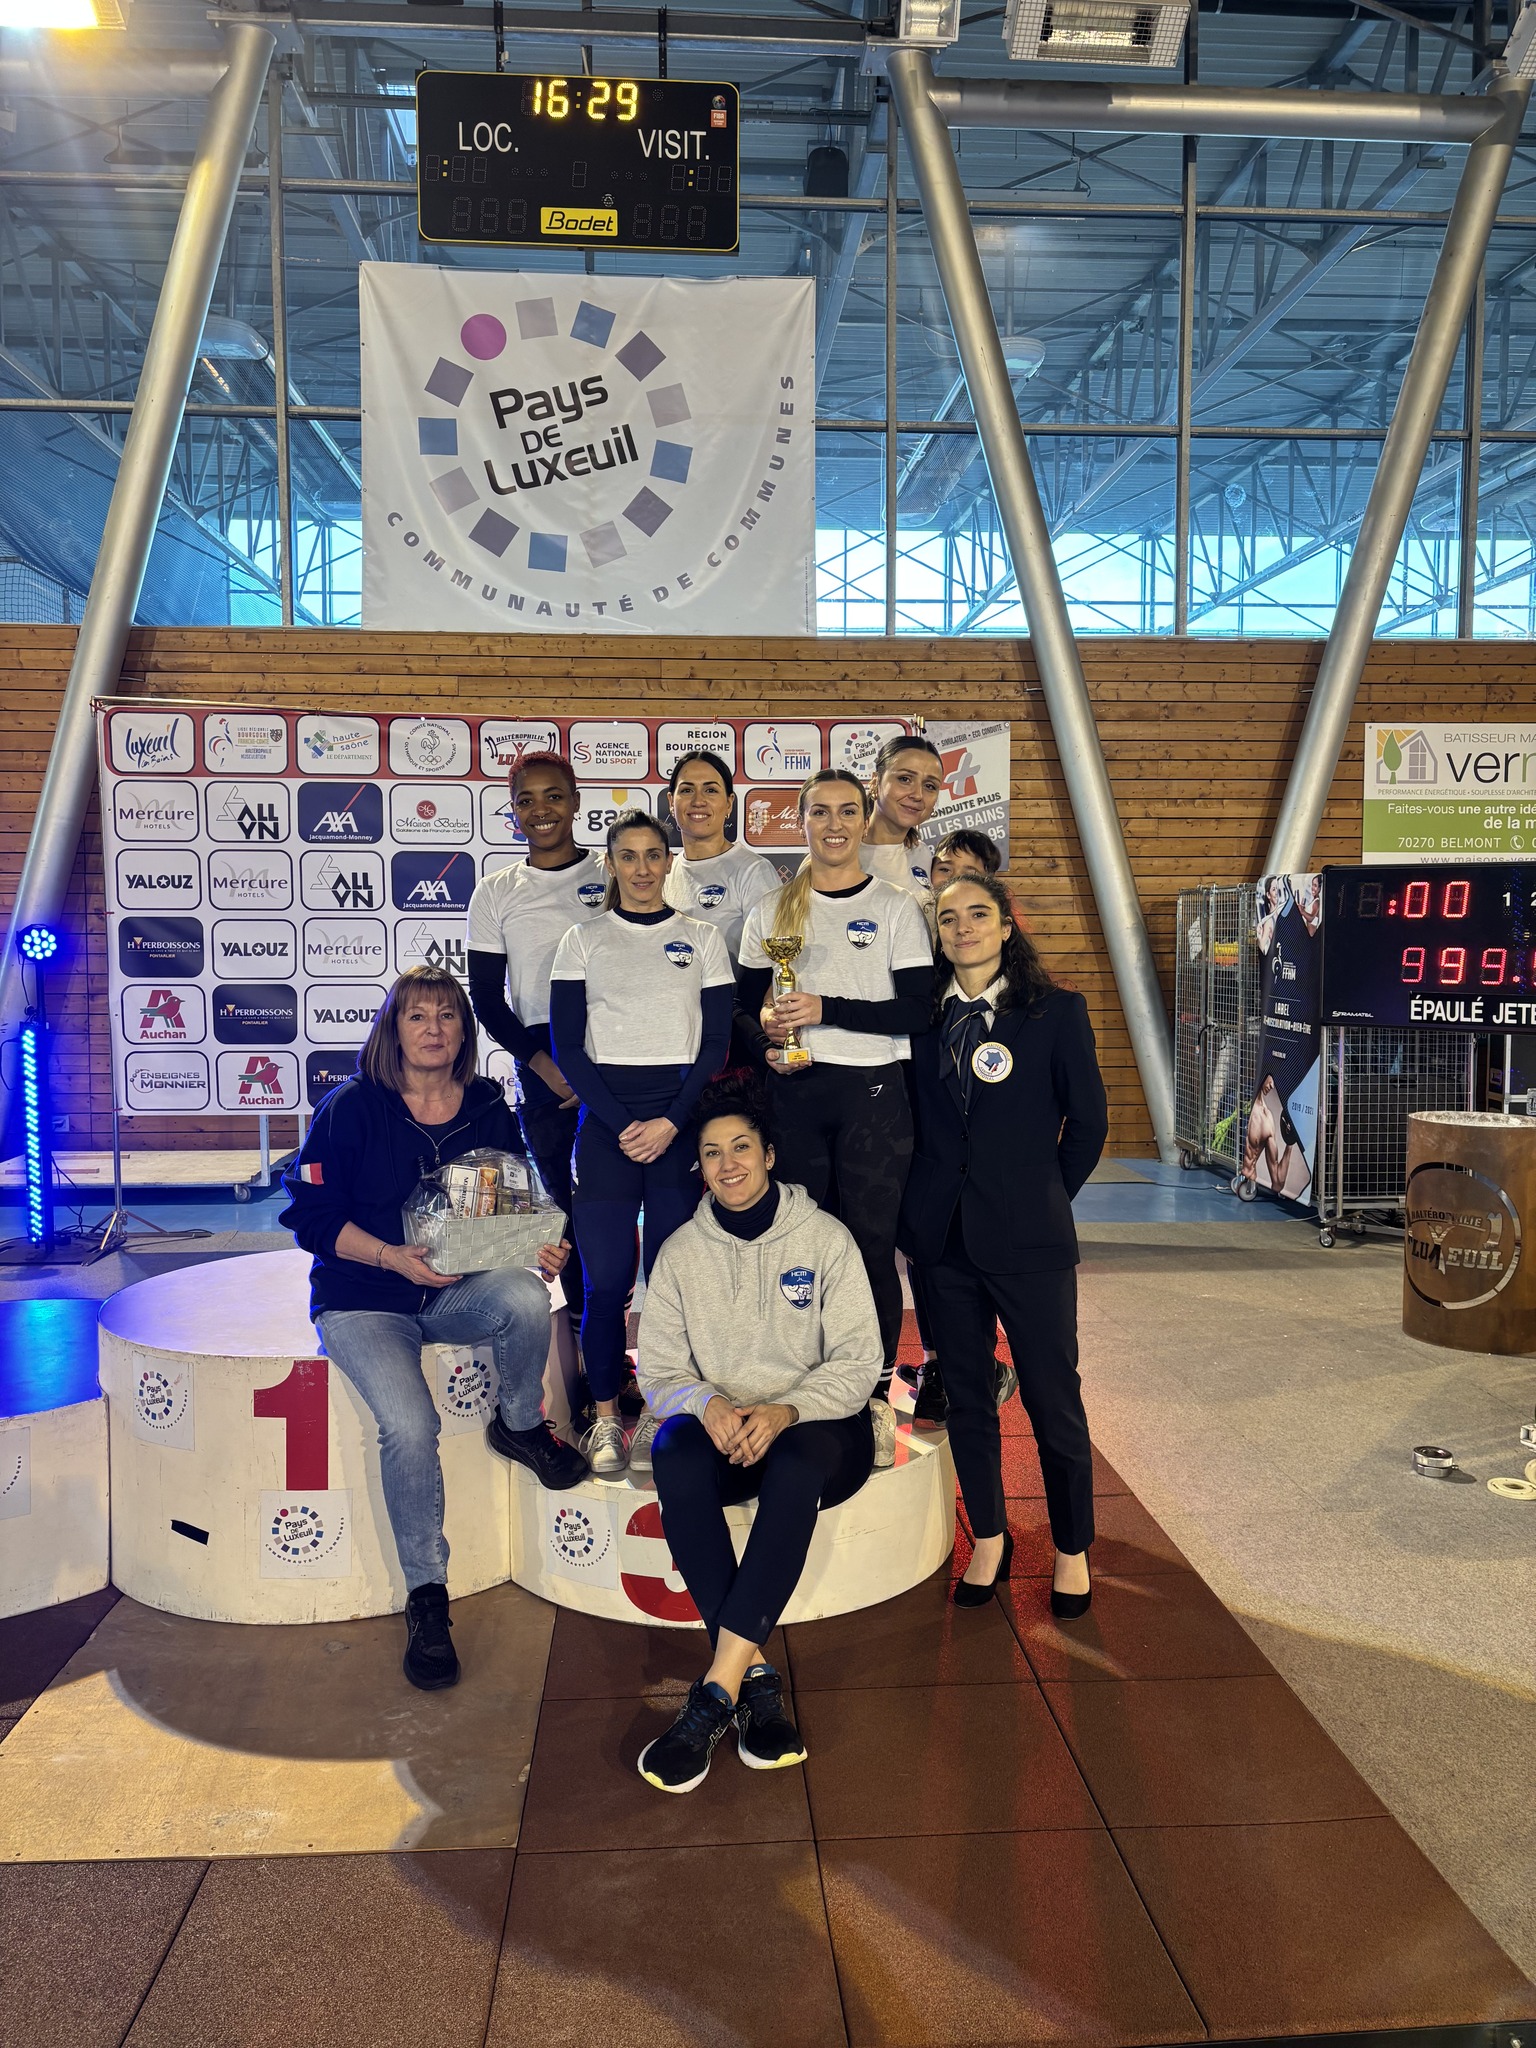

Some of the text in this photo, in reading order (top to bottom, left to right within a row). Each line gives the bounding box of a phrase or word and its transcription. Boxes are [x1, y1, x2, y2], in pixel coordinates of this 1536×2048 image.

[532, 79, 639, 120] 16:29
[458, 121, 520, 153] LOC.
[637, 128, 710, 160] VISIT.
[545, 211, 614, 232] Bodet
[489, 374, 609, 430] Pays
[519, 424, 563, 455] DE
[483, 424, 639, 496] Luxeuil
[387, 511, 634, 618] COMMUNAUTÉ
[652, 572, 694, 604] DE
[707, 375, 795, 569] COMMUNES
[427, 723, 451, 736] NATIONAL
[941, 733, 968, 747] SIMULATEUR
[972, 731, 982, 739] ECO
[981, 724, 1002, 736] CONDUITE
[332, 731, 361, 742] haute
[496, 733, 545, 742] HALTÉROPHILIE
[1444, 733, 1516, 743] BATISSEUR
[340, 739, 369, 751] saône
[665, 743, 730, 752] BOURGOGNE
[855, 741, 873, 750] Pays
[853, 748, 877, 760] Luxeuil
[784, 755, 811, 770] FFHM
[1424, 788, 1467, 796] ÉNERGÉTIQUE
[1471, 788, 1506, 796] SOUPLESSE
[931, 792, 1002, 818] ONDUITE PLUS
[1387, 803, 1455, 815] Faites-vous
[1458, 805, 1481, 815] une
[1484, 804, 1516, 815] autre
[119, 808, 195, 821] Mercure
[587, 809, 624, 832] ga
[938, 817, 963, 836] LES
[964, 806, 1006, 829] BAINS
[313, 811, 359, 833] AXA
[396, 817, 431, 828] Maison
[1483, 816, 1503, 829] de
[1507, 816, 1521, 829] la
[309, 834, 373, 842] Jacquamond-Monney
[987, 825, 1006, 842] 95
[1398, 837, 1435, 848] 70270
[1441, 837, 1502, 848] BELMONT
[125, 874, 193, 889] YALOUZ
[213, 876, 288, 889] Mercure
[407, 880, 452, 901] AXA
[1502, 891, 1511, 907] 1
[403, 902, 466, 910] Jacquamond-Monney
[127, 937, 201, 949] HYPERBOISSONS
[307, 943, 382, 956] Mercure
[221, 943, 289, 957] YALOUZ
[219, 1004, 293, 1016] HYPERBOISSONS
[1274, 1002, 1290, 1016] LABEL
[1332, 1010, 1374, 1018] STRAMATEL
[1410, 994, 1484, 1023] ÉPAULÉ
[140, 1030, 187, 1039] Auchan
[140, 1079, 206, 1089] MONNIER
[239, 1095, 285, 1105] Auchan
[459, 1372, 479, 1386] Pays
[146, 1385, 161, 1395] Pays
[458, 1380, 483, 1398] Luxeuil
[146, 1394, 166, 1406] Luxeuil
[254, 1360, 328, 1490] 1
[284, 1518, 308, 1530] Pays
[563, 1522, 582, 1532] Pays
[283, 1528, 314, 1542] Luxeuil
[563, 1533, 586, 1542] Luxeuil
